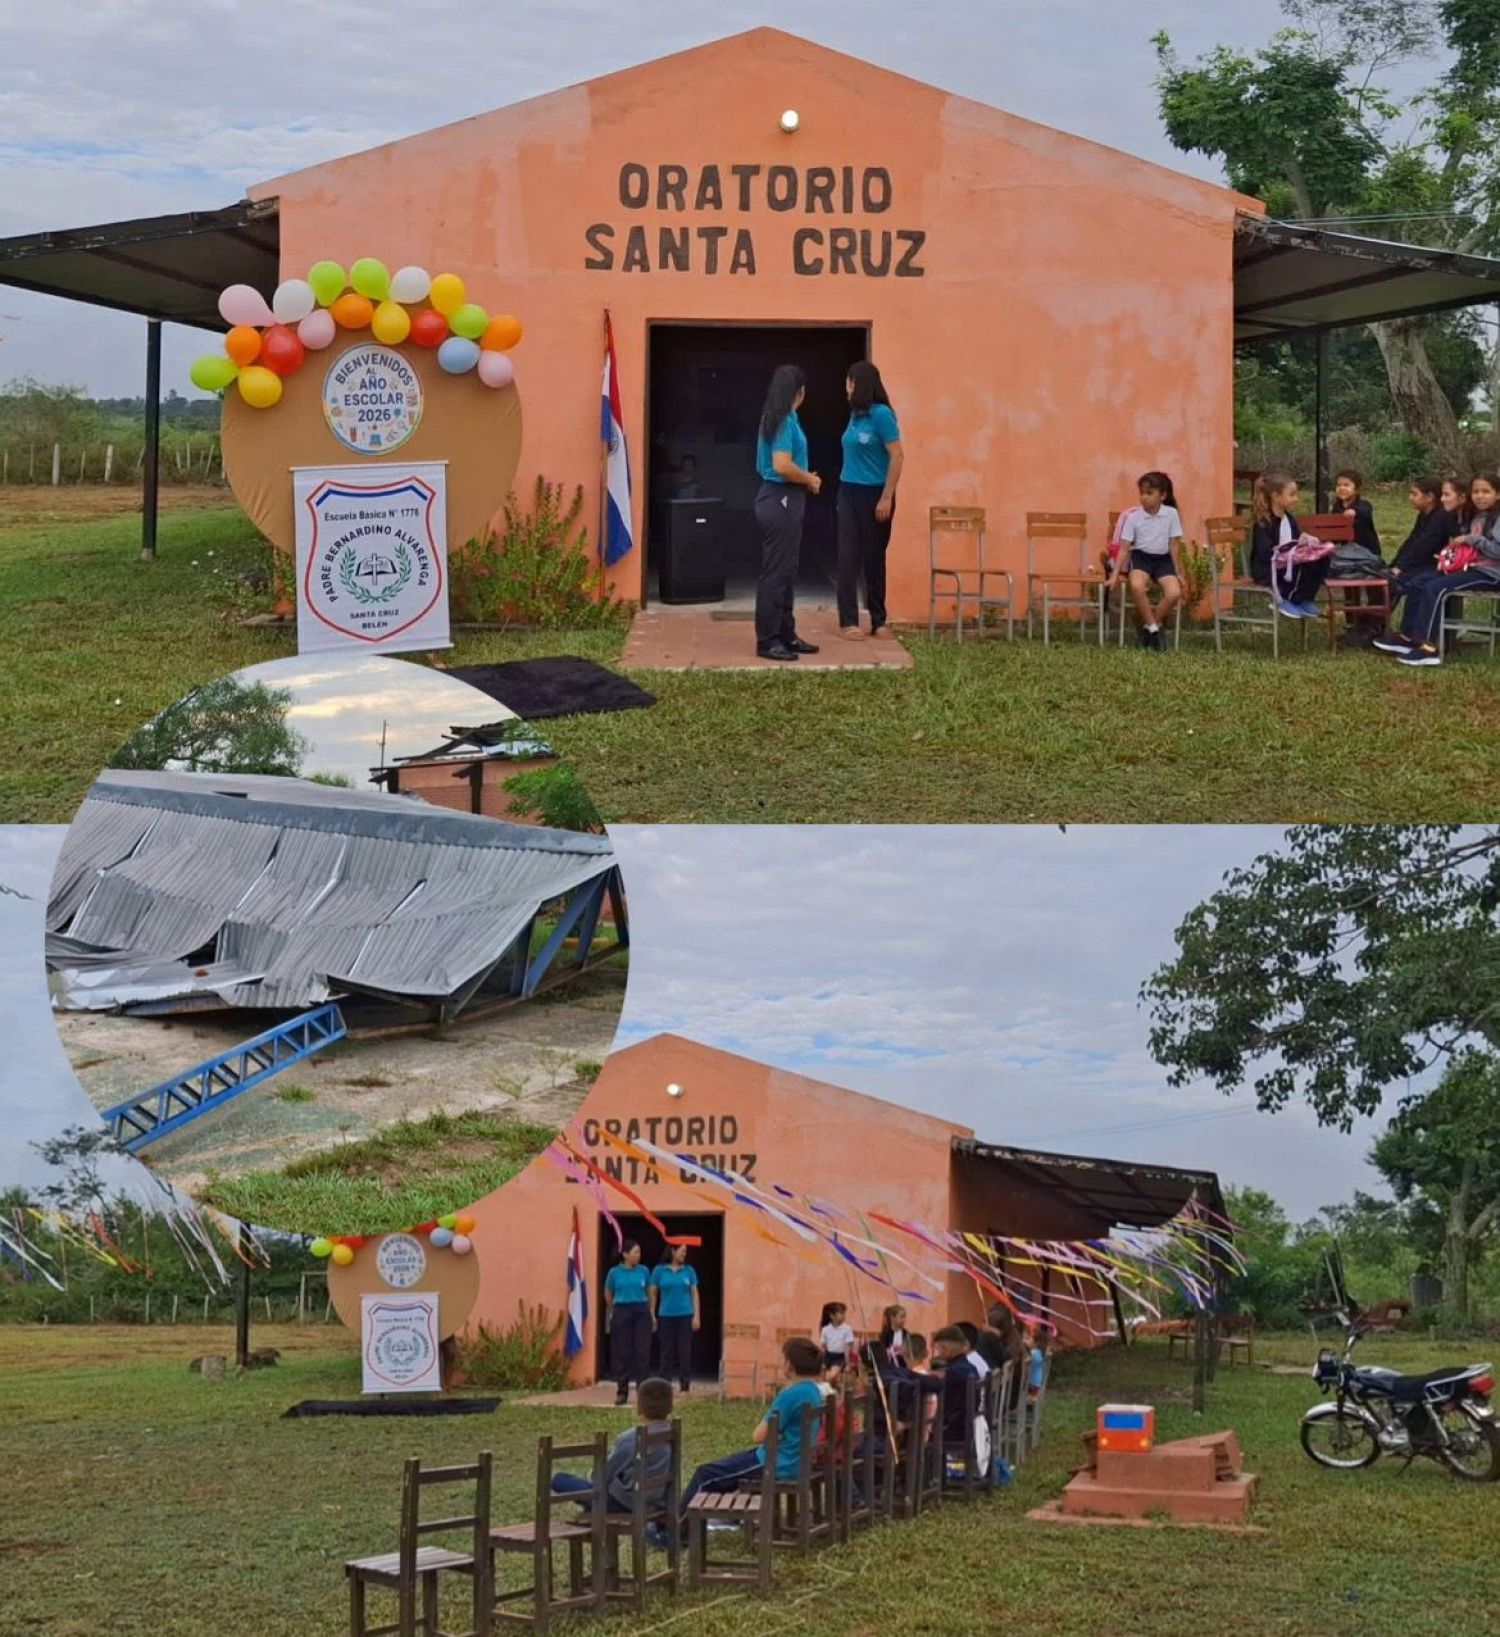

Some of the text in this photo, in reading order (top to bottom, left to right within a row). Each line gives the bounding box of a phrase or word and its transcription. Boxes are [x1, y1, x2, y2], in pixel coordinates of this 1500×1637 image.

[619, 162, 892, 214] ORATORIO
[585, 223, 926, 278] SANTA CRUZ
[335, 353, 413, 386] BIENVENIDOS
[366, 367, 377, 375] AL
[359, 375, 387, 390] AÑO
[344, 392, 404, 406] ESCOLAR
[358, 409, 391, 422] 2026
[324, 511, 357, 521] Escuela
[321, 525, 429, 603] PADRE BERNARDINO ALVARENGA
